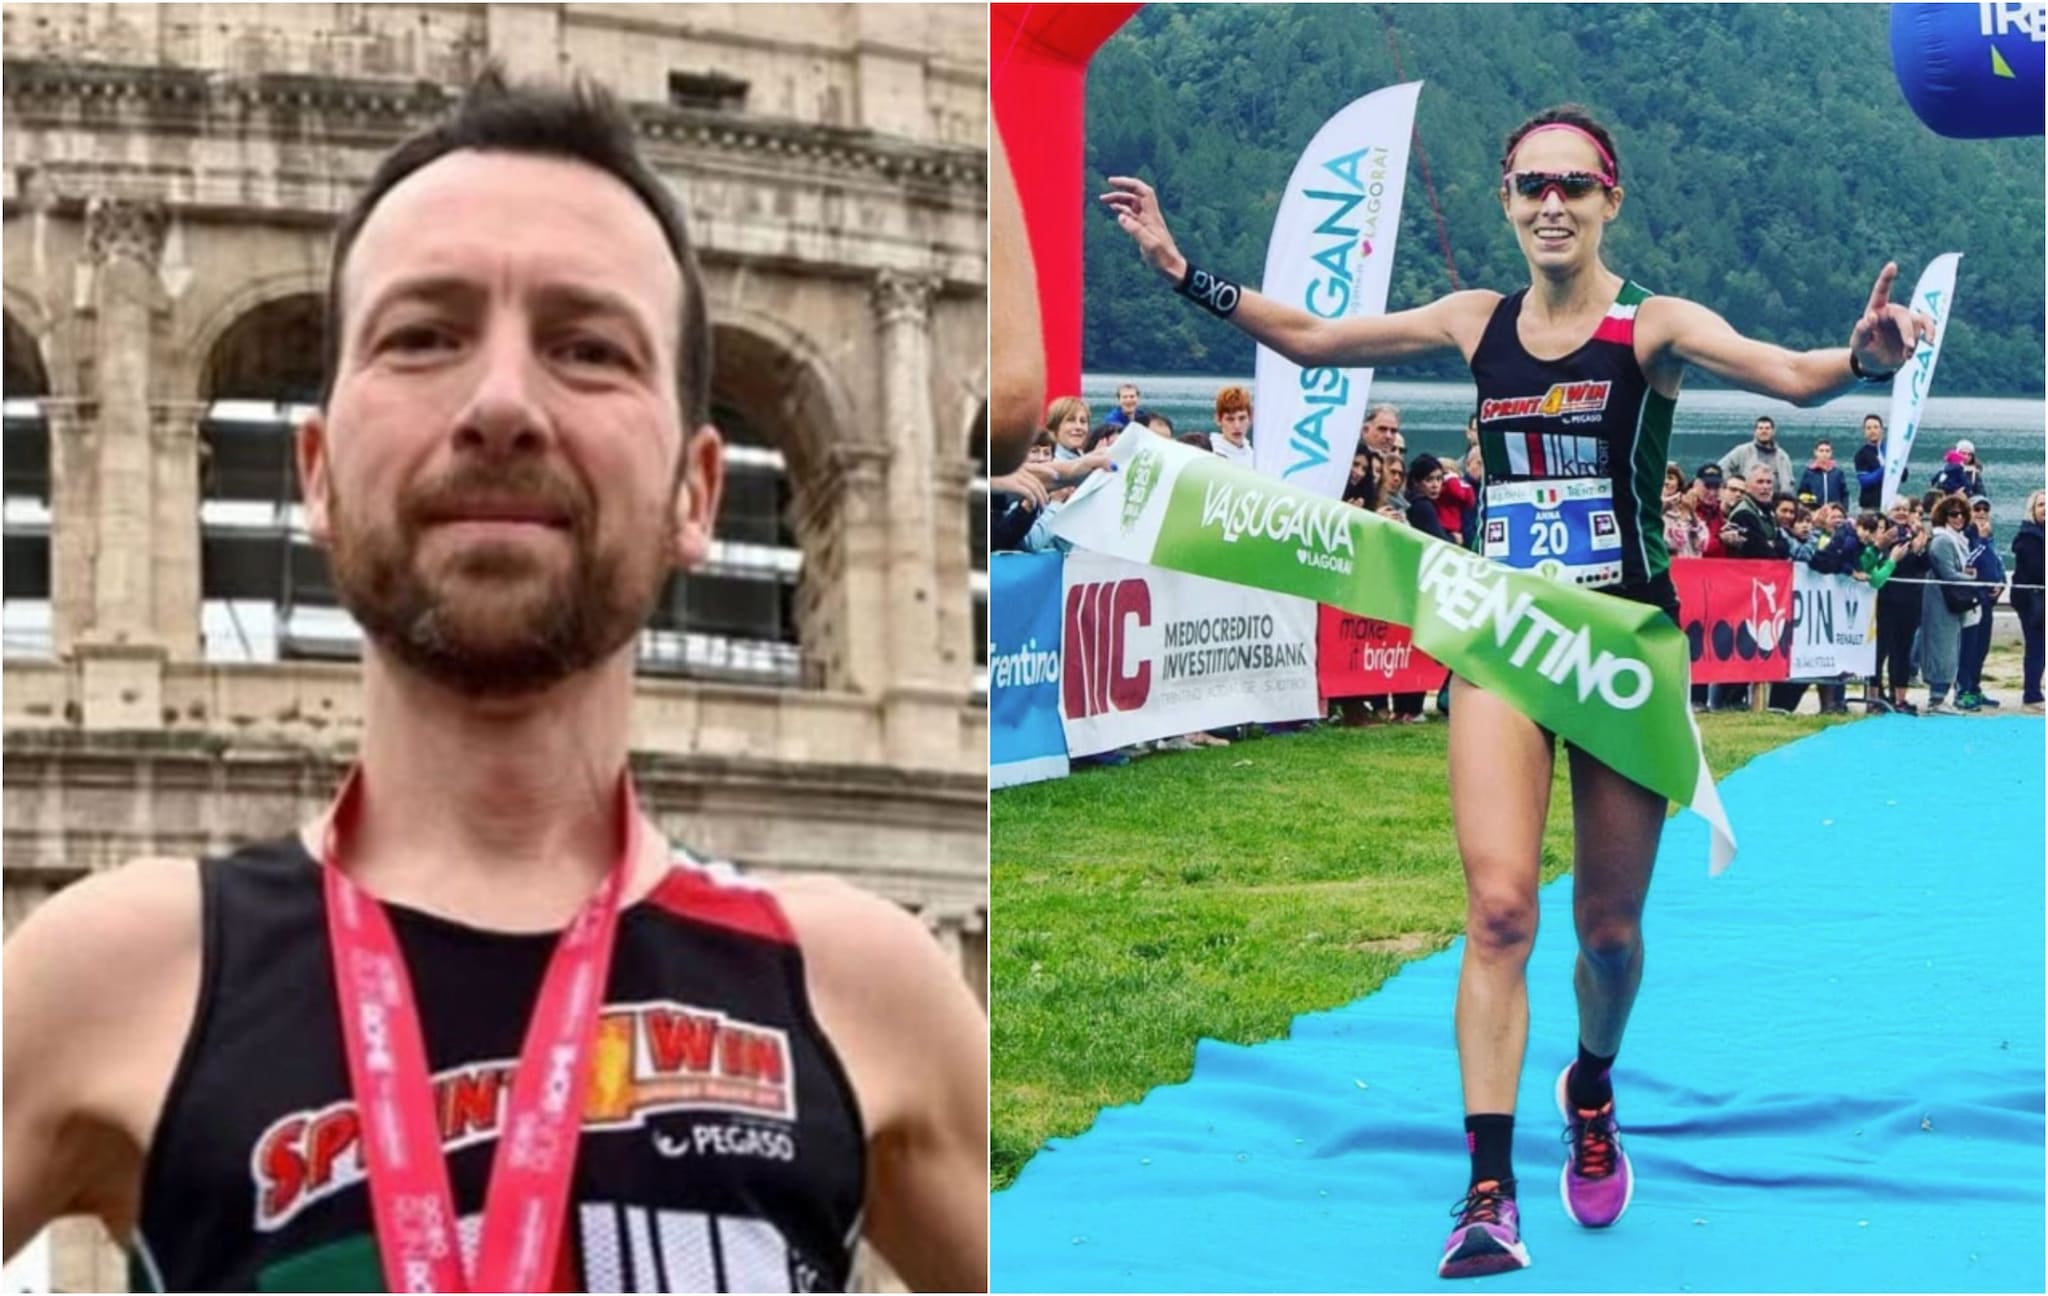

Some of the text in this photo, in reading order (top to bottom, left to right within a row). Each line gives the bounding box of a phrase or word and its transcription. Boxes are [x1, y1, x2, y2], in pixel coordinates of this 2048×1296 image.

[1366, 146, 1389, 238] LAGORAI
[1283, 146, 1371, 479] VALSGANA
[1482, 396, 1542, 421] SPRINT
[1540, 385, 1565, 415] 4
[1202, 480, 1354, 556] VALSUGANA
[1530, 522, 1569, 556] 20
[1164, 614, 1273, 649] MEDIOCREDITO
[991, 638, 1059, 689] rentino
[1163, 642, 1308, 681] INVESTITIONSBANK
[1363, 640, 1412, 680] bright
[254, 1058, 516, 1226] SPIN
[643, 1006, 786, 1084] WIN
[692, 1126, 794, 1161] PEGASO
